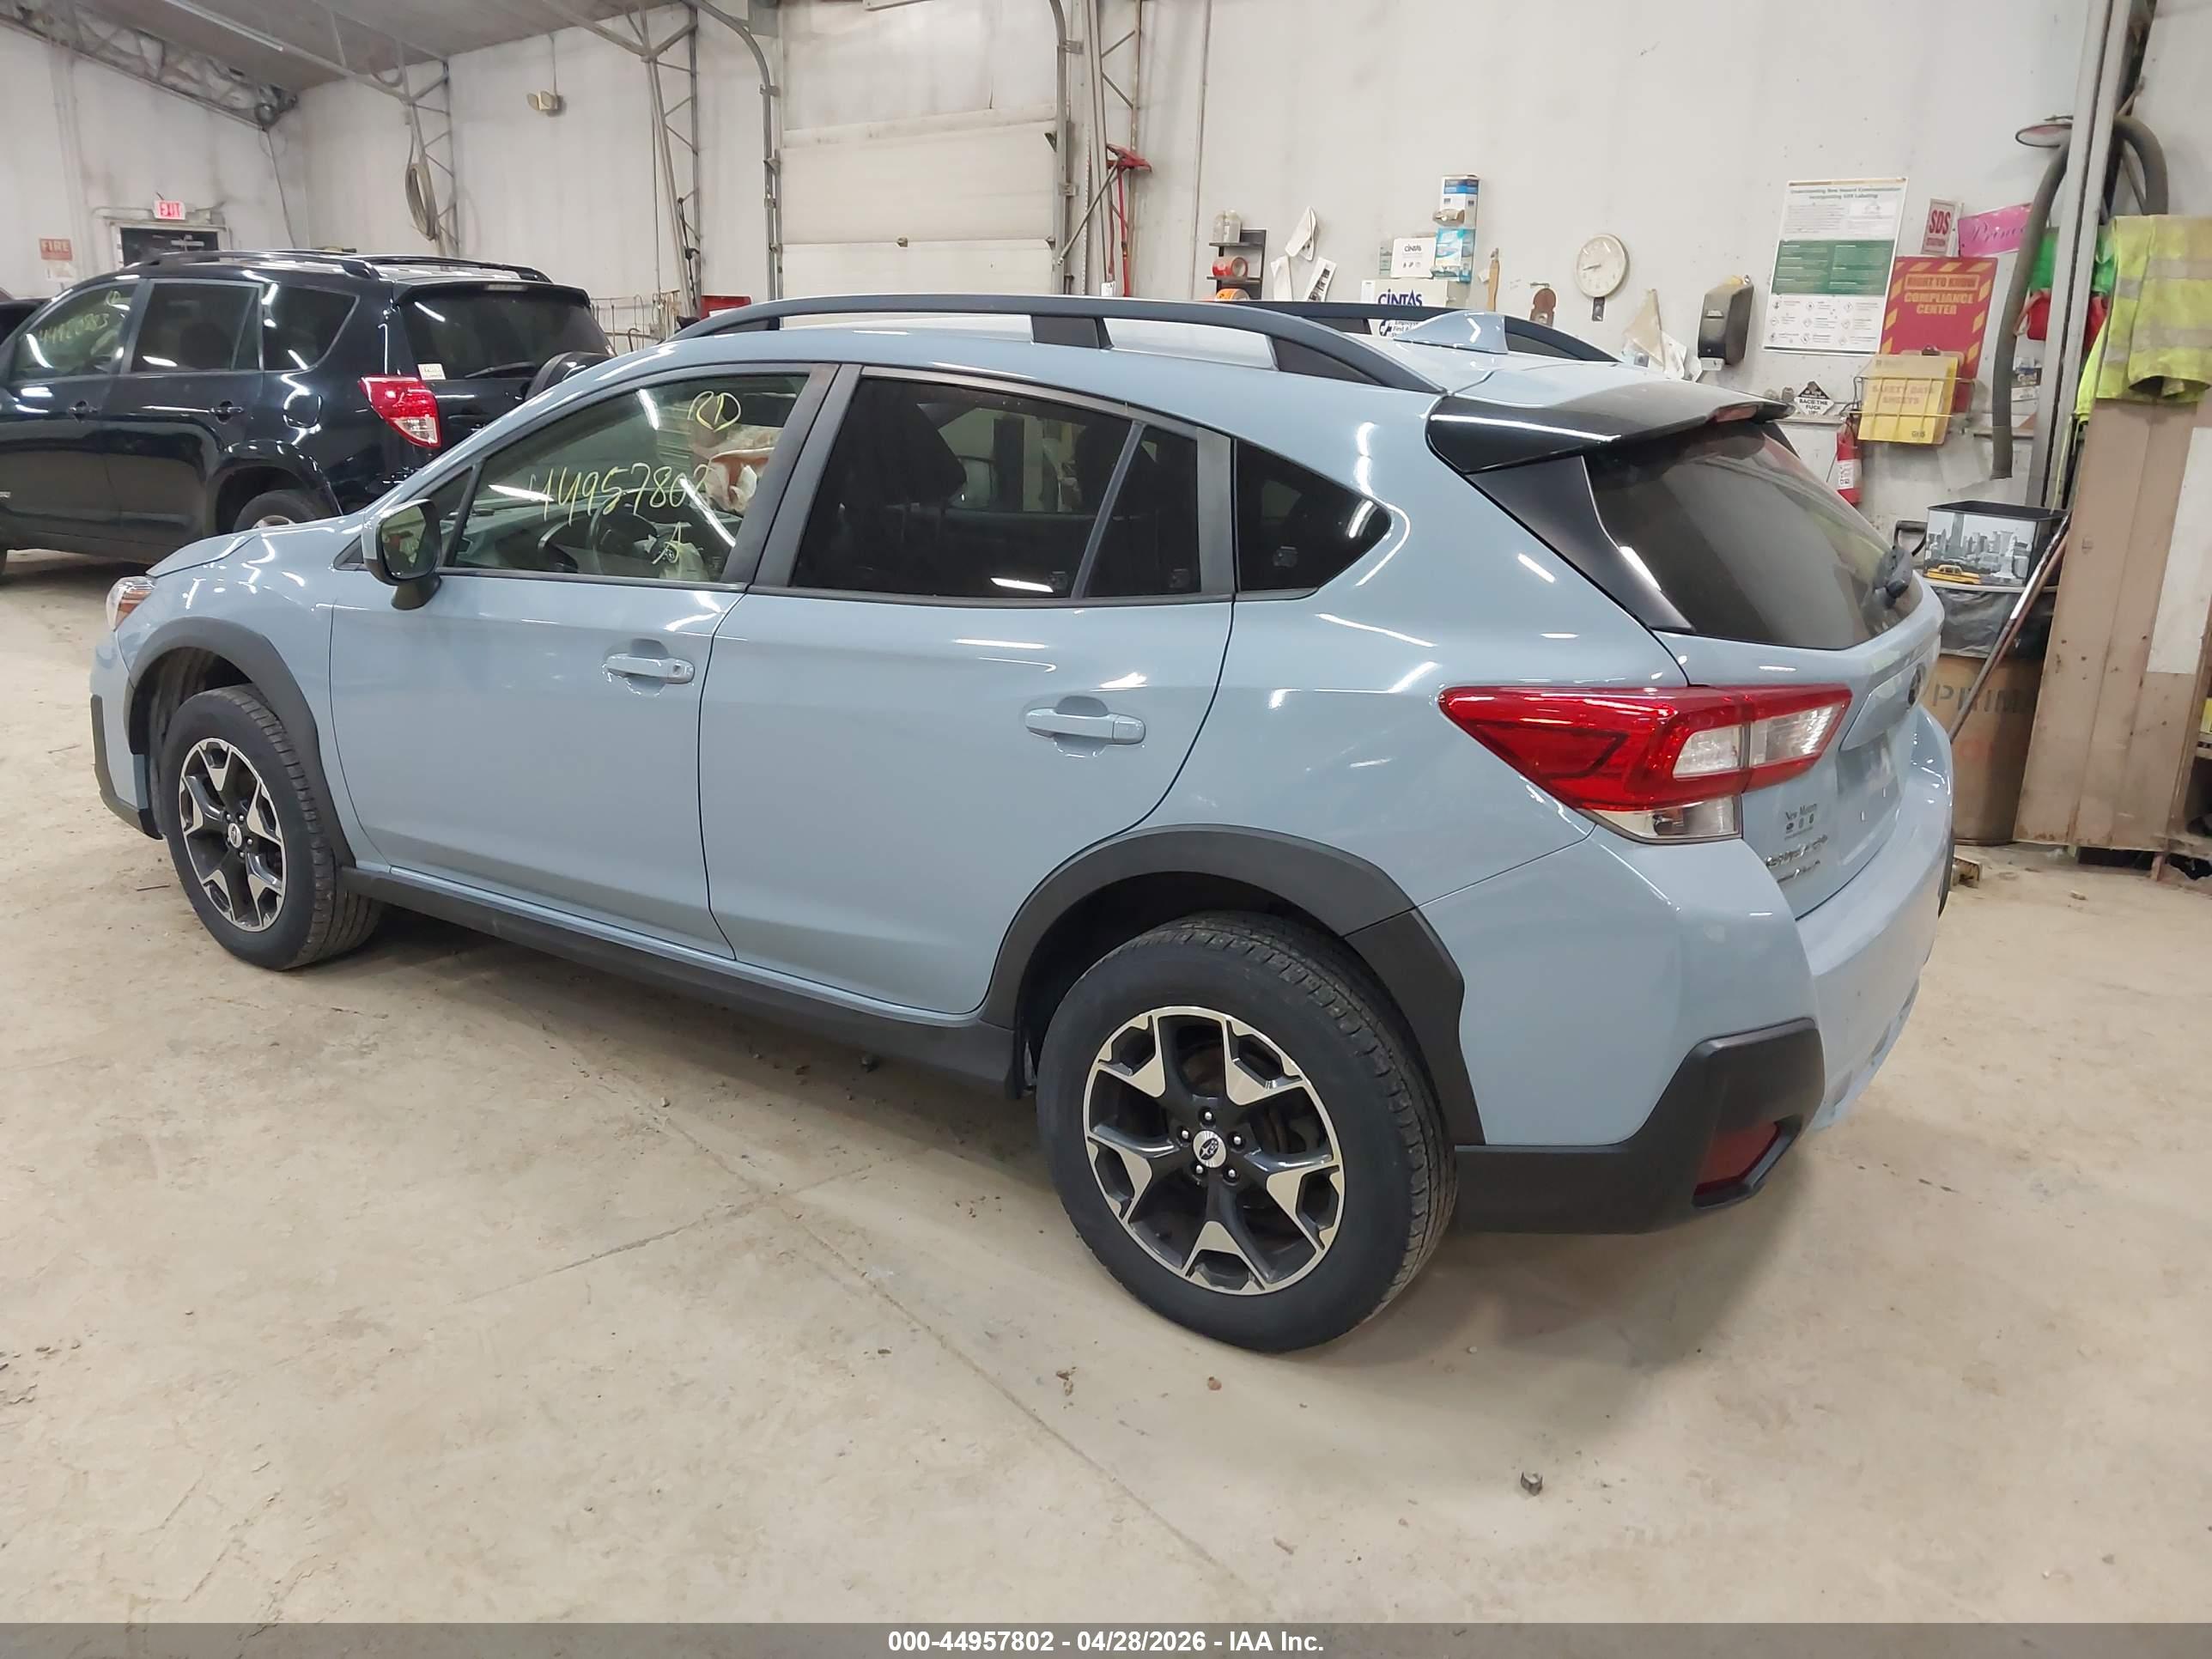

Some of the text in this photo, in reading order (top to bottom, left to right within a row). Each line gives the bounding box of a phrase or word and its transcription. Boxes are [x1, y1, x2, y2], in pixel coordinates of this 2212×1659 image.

[160, 202, 180, 218] EXIT
[1929, 210, 1951, 235] SDS
[41, 240, 70, 252] FIRE
[1904, 292, 1974, 304] COMPLIANCE
[1916, 303, 1958, 315] CENTER
